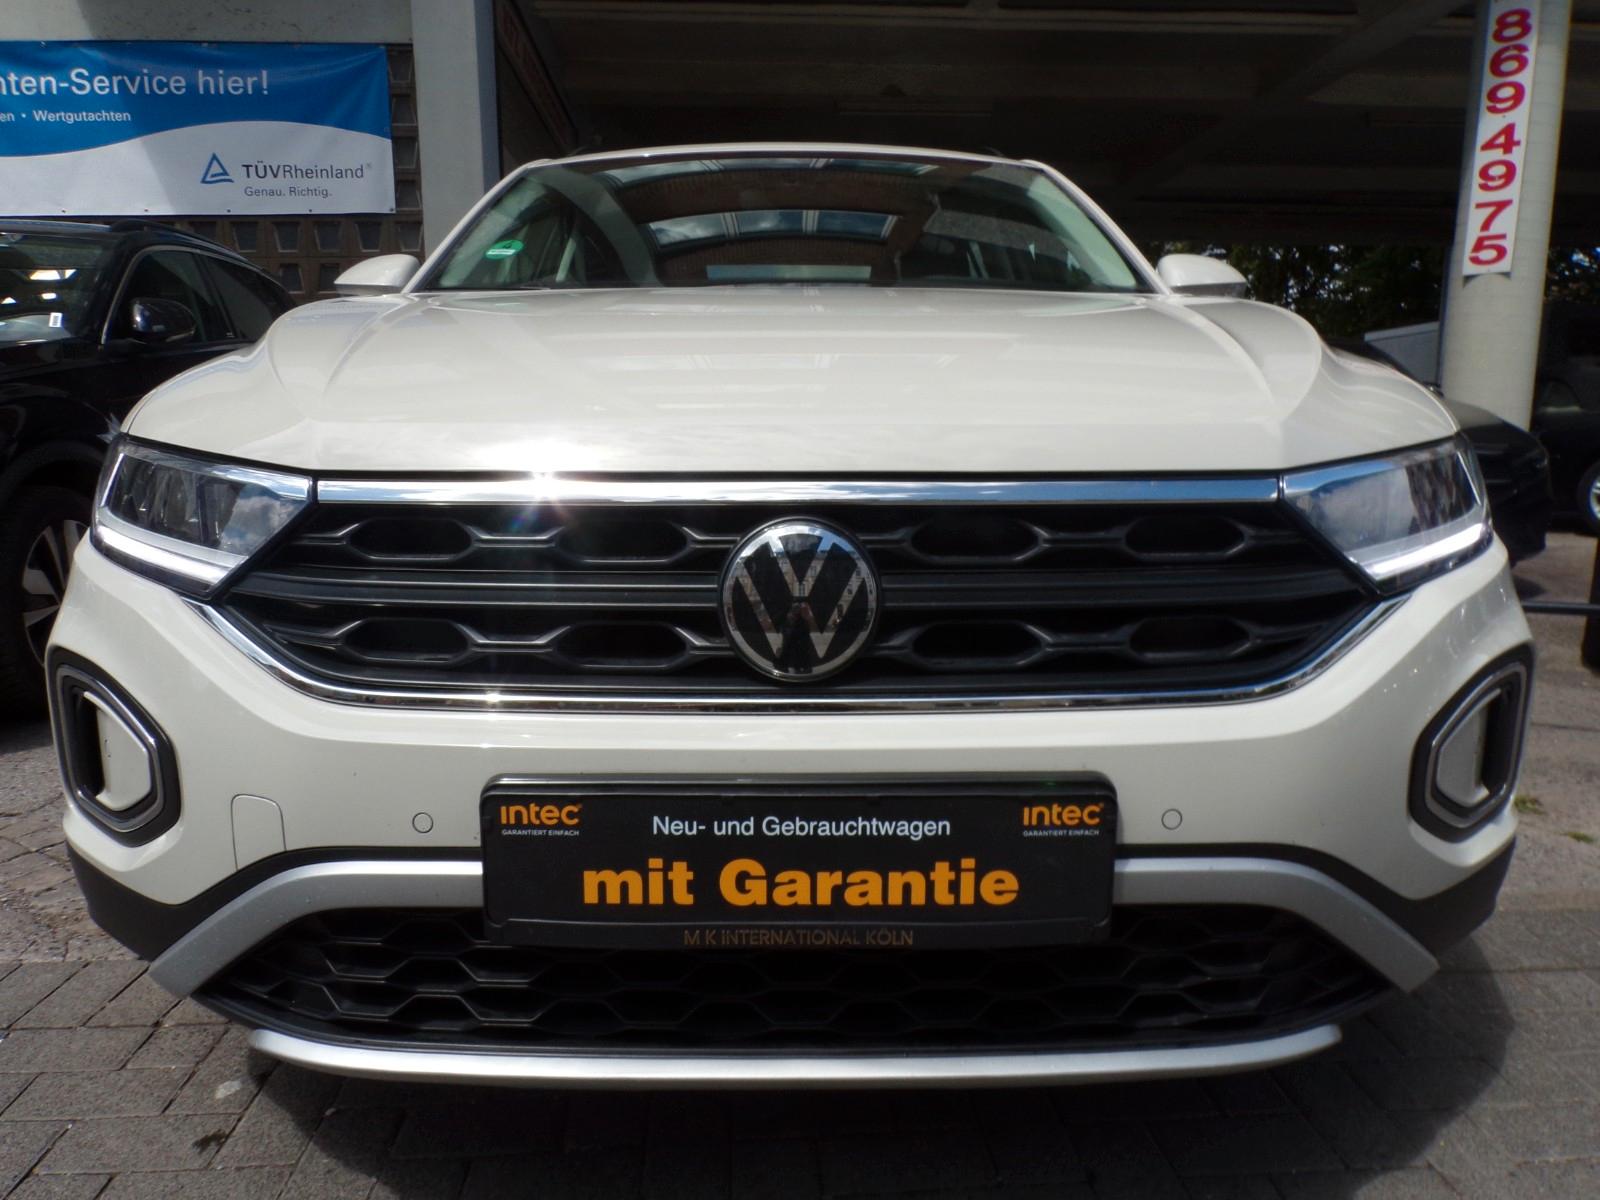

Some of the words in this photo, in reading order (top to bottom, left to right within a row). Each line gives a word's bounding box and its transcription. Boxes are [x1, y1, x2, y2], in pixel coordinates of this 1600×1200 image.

[199, 69, 269, 95] hier!
[33, 110, 131, 124] Wertgutachten
[1468, 8, 1532, 266] 8694975
[244, 186, 285, 197] Genau.
[289, 185, 333, 199] Richtig.
[500, 803, 579, 826] intec
[1023, 803, 1101, 826] intec
[501, 829, 547, 837] GARANTIERT
[652, 815, 706, 836] Neu-
[713, 815, 755, 836] und
[762, 815, 951, 841] Gebrauchtwagen
[1022, 829, 1067, 838] GARANTIERT
[1068, 828, 1100, 836] EINFACH
[583, 858, 694, 905] mit
[719, 858, 1020, 906] Garantie
[721, 929, 861, 945] INTERNATIONAL
[865, 927, 914, 945] KÖLN
